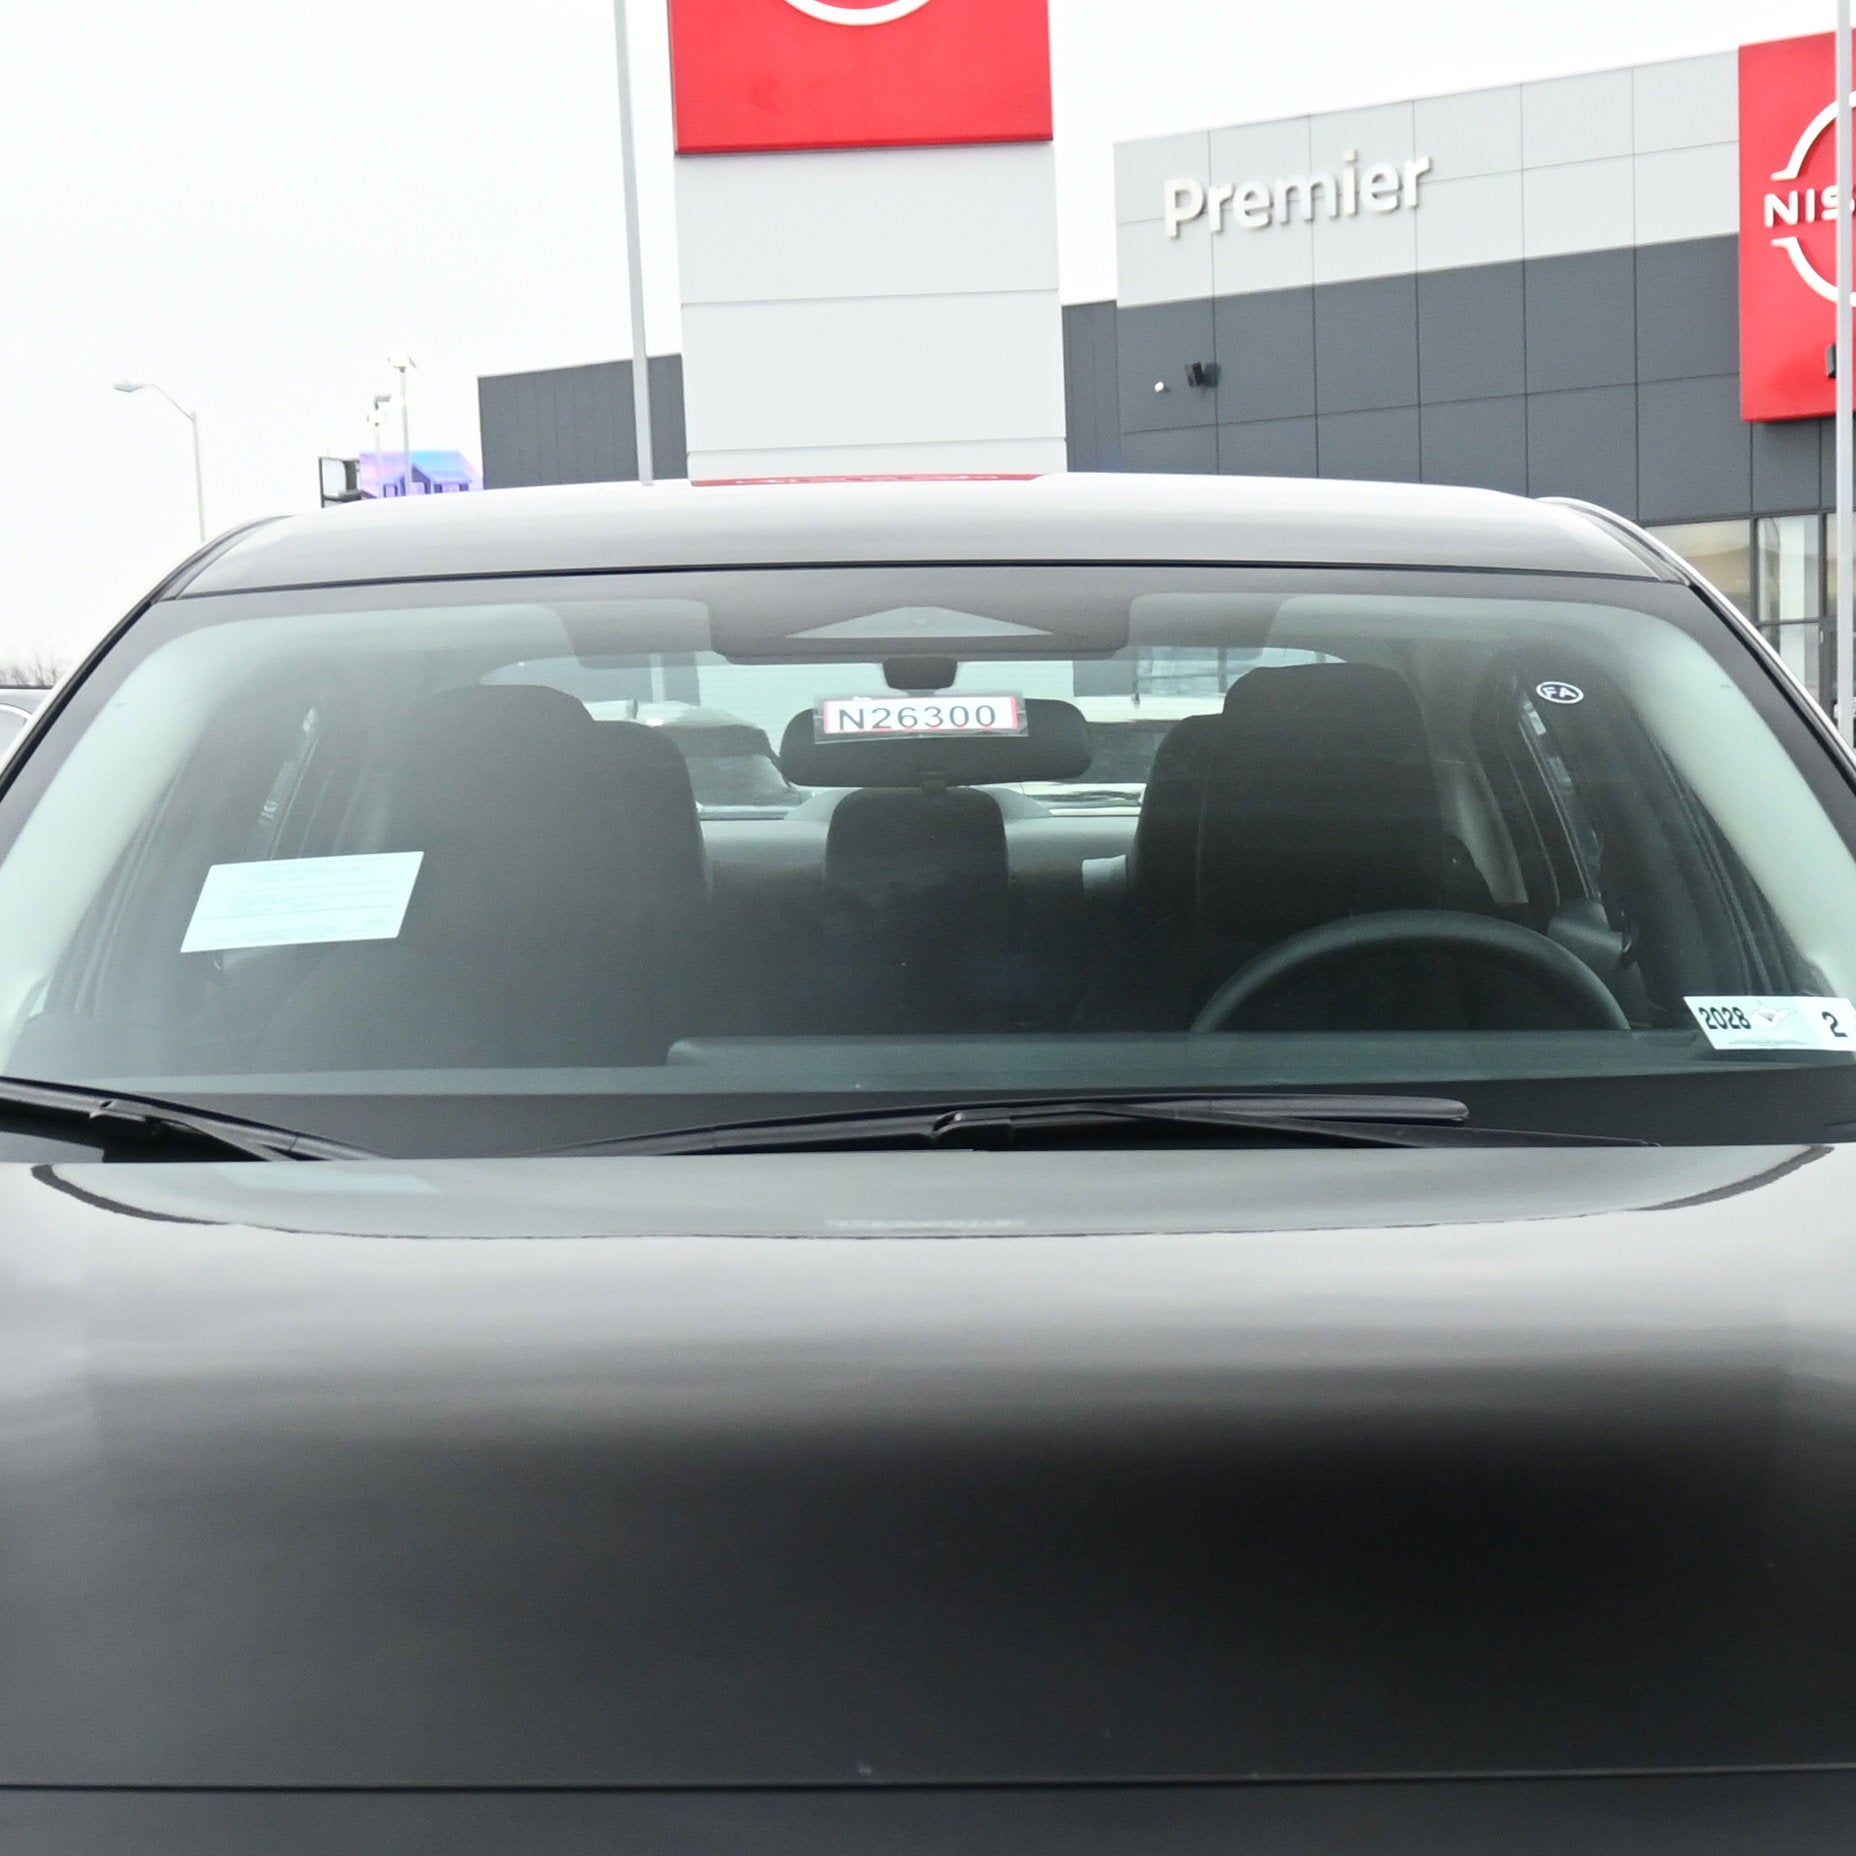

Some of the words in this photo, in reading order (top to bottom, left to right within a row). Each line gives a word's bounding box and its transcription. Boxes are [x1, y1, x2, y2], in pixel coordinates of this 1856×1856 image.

[1163, 148, 1432, 239] Premier
[838, 704, 996, 730] N26300
[1698, 1006, 1752, 1030] 2028
[1821, 1011, 1848, 1038] 2
